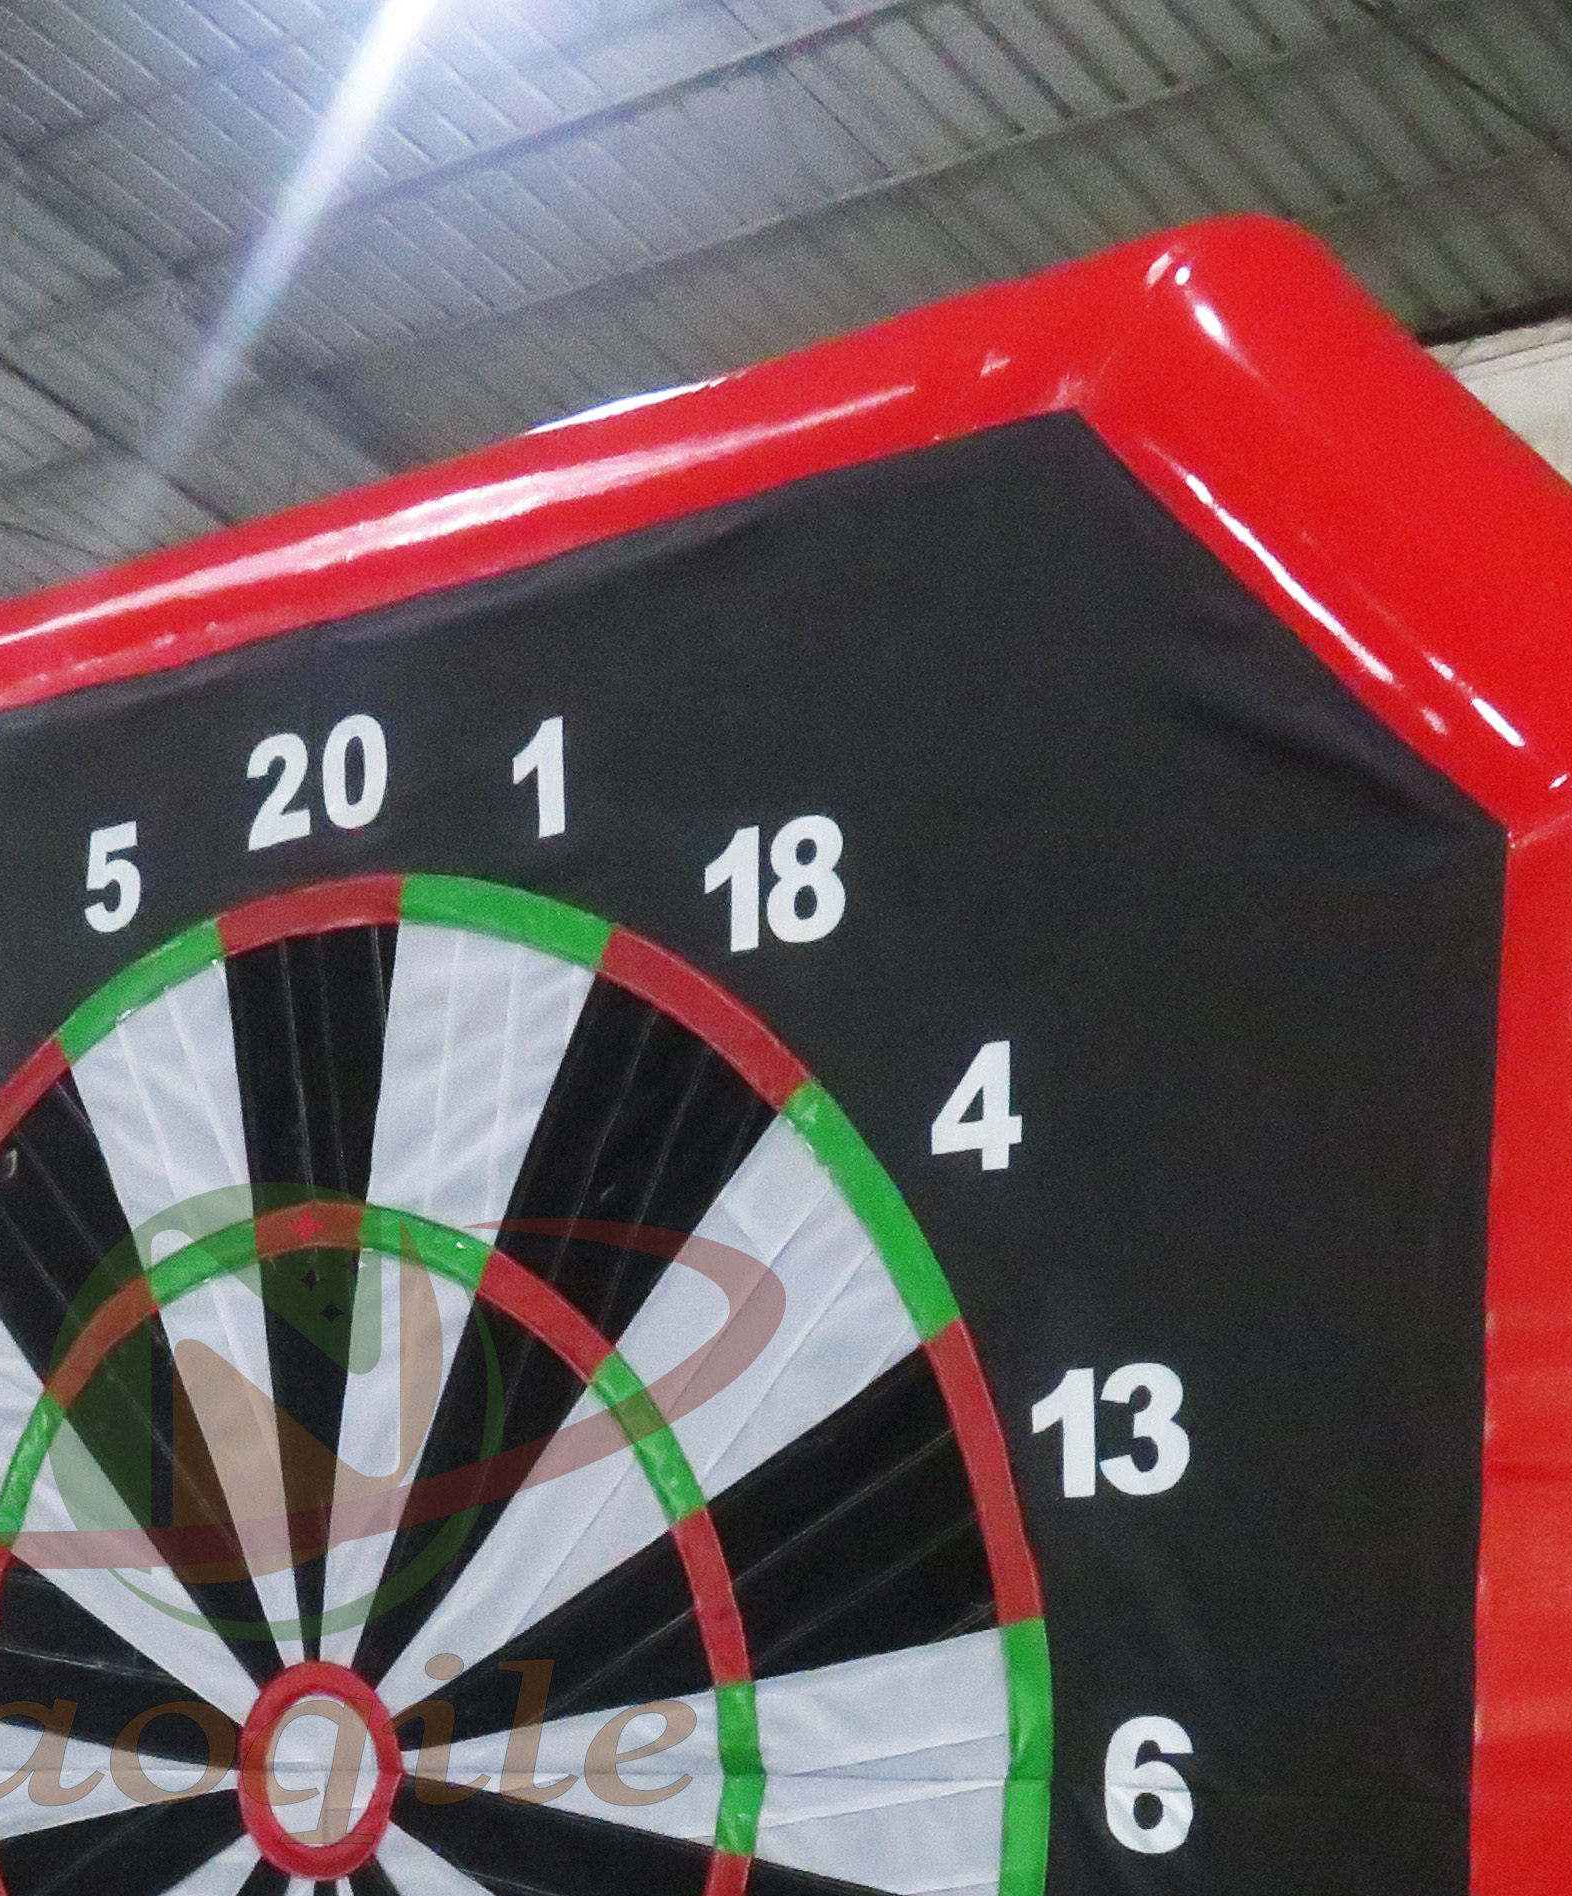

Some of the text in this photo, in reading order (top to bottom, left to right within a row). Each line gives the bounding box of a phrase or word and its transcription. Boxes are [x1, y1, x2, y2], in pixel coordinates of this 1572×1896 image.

[247, 714, 387, 851] 20
[513, 716, 565, 838] 1
[85, 821, 141, 932] 5
[705, 815, 845, 952] 18
[931, 1041, 1022, 1170] 4
[1032, 1363, 1190, 1498] 13
[1105, 1716, 1193, 1853] 6
